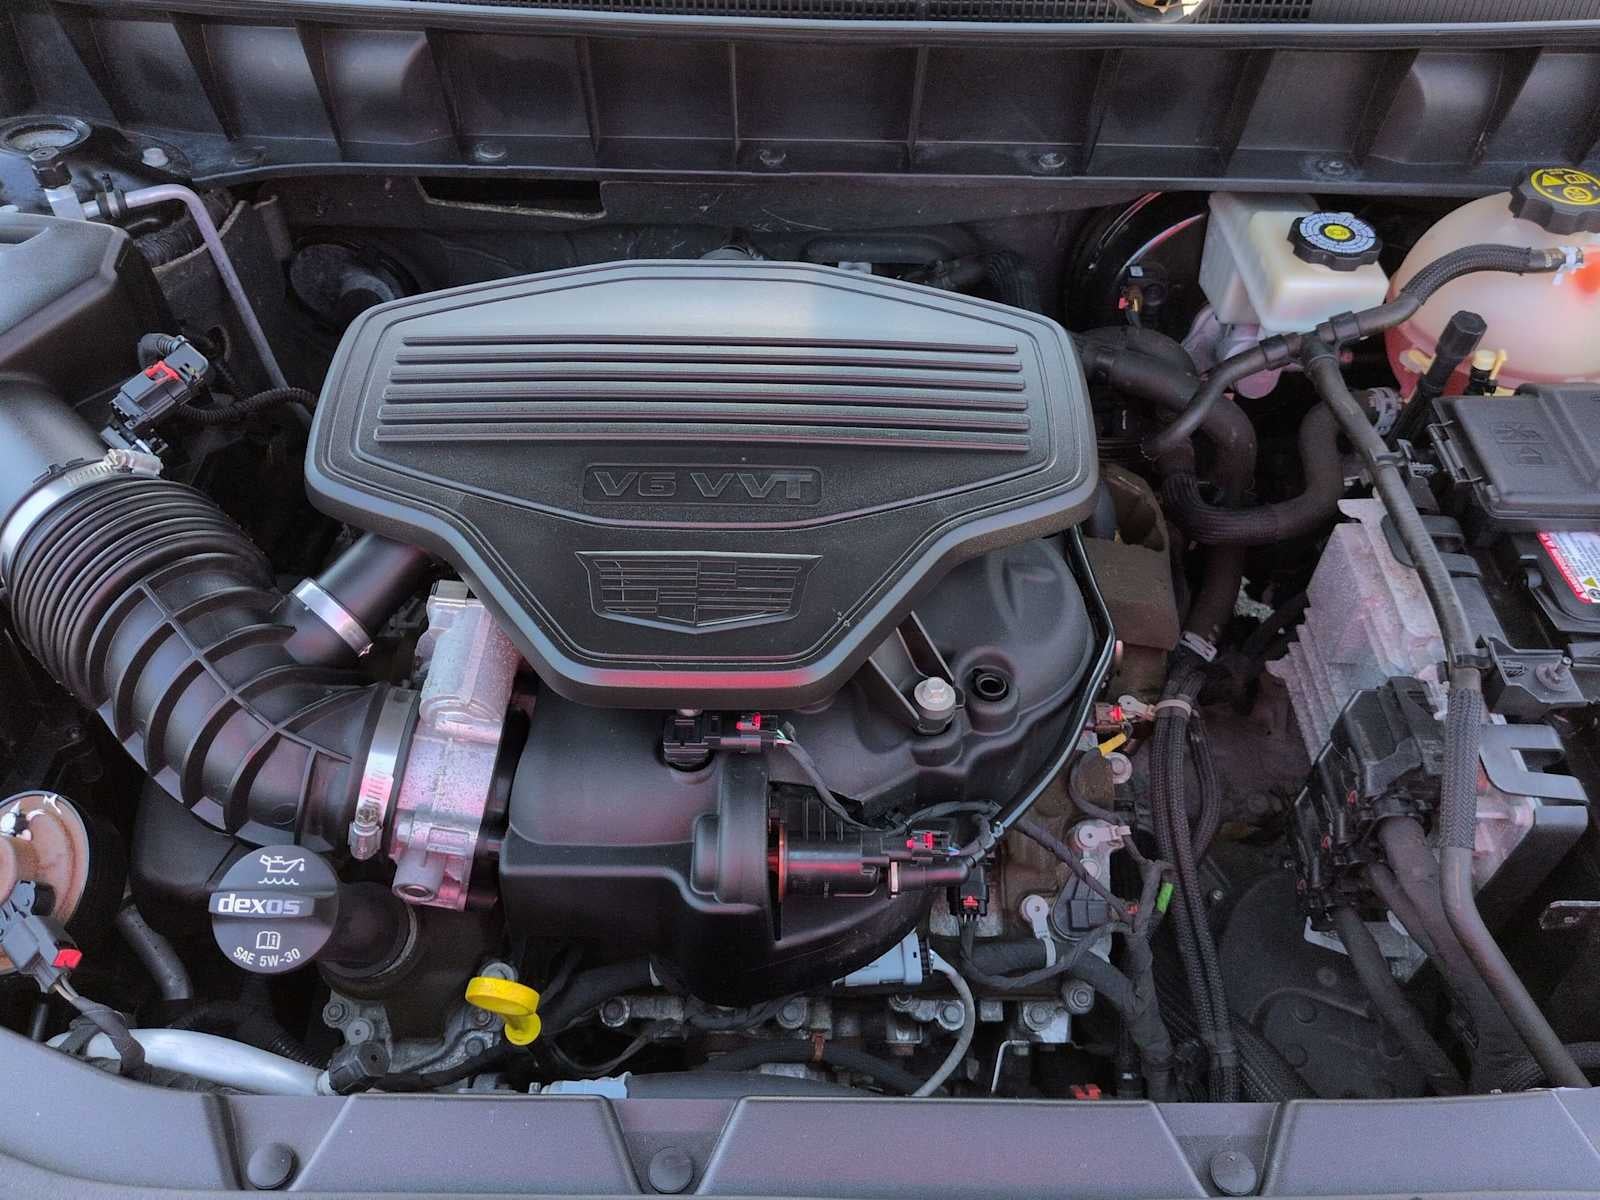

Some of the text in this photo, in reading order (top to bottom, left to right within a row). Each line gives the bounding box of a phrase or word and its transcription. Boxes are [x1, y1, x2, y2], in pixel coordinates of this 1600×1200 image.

[593, 471, 813, 499] V6 VVT
[217, 893, 304, 915] dexos
[233, 946, 301, 967] SAE 5W-30
